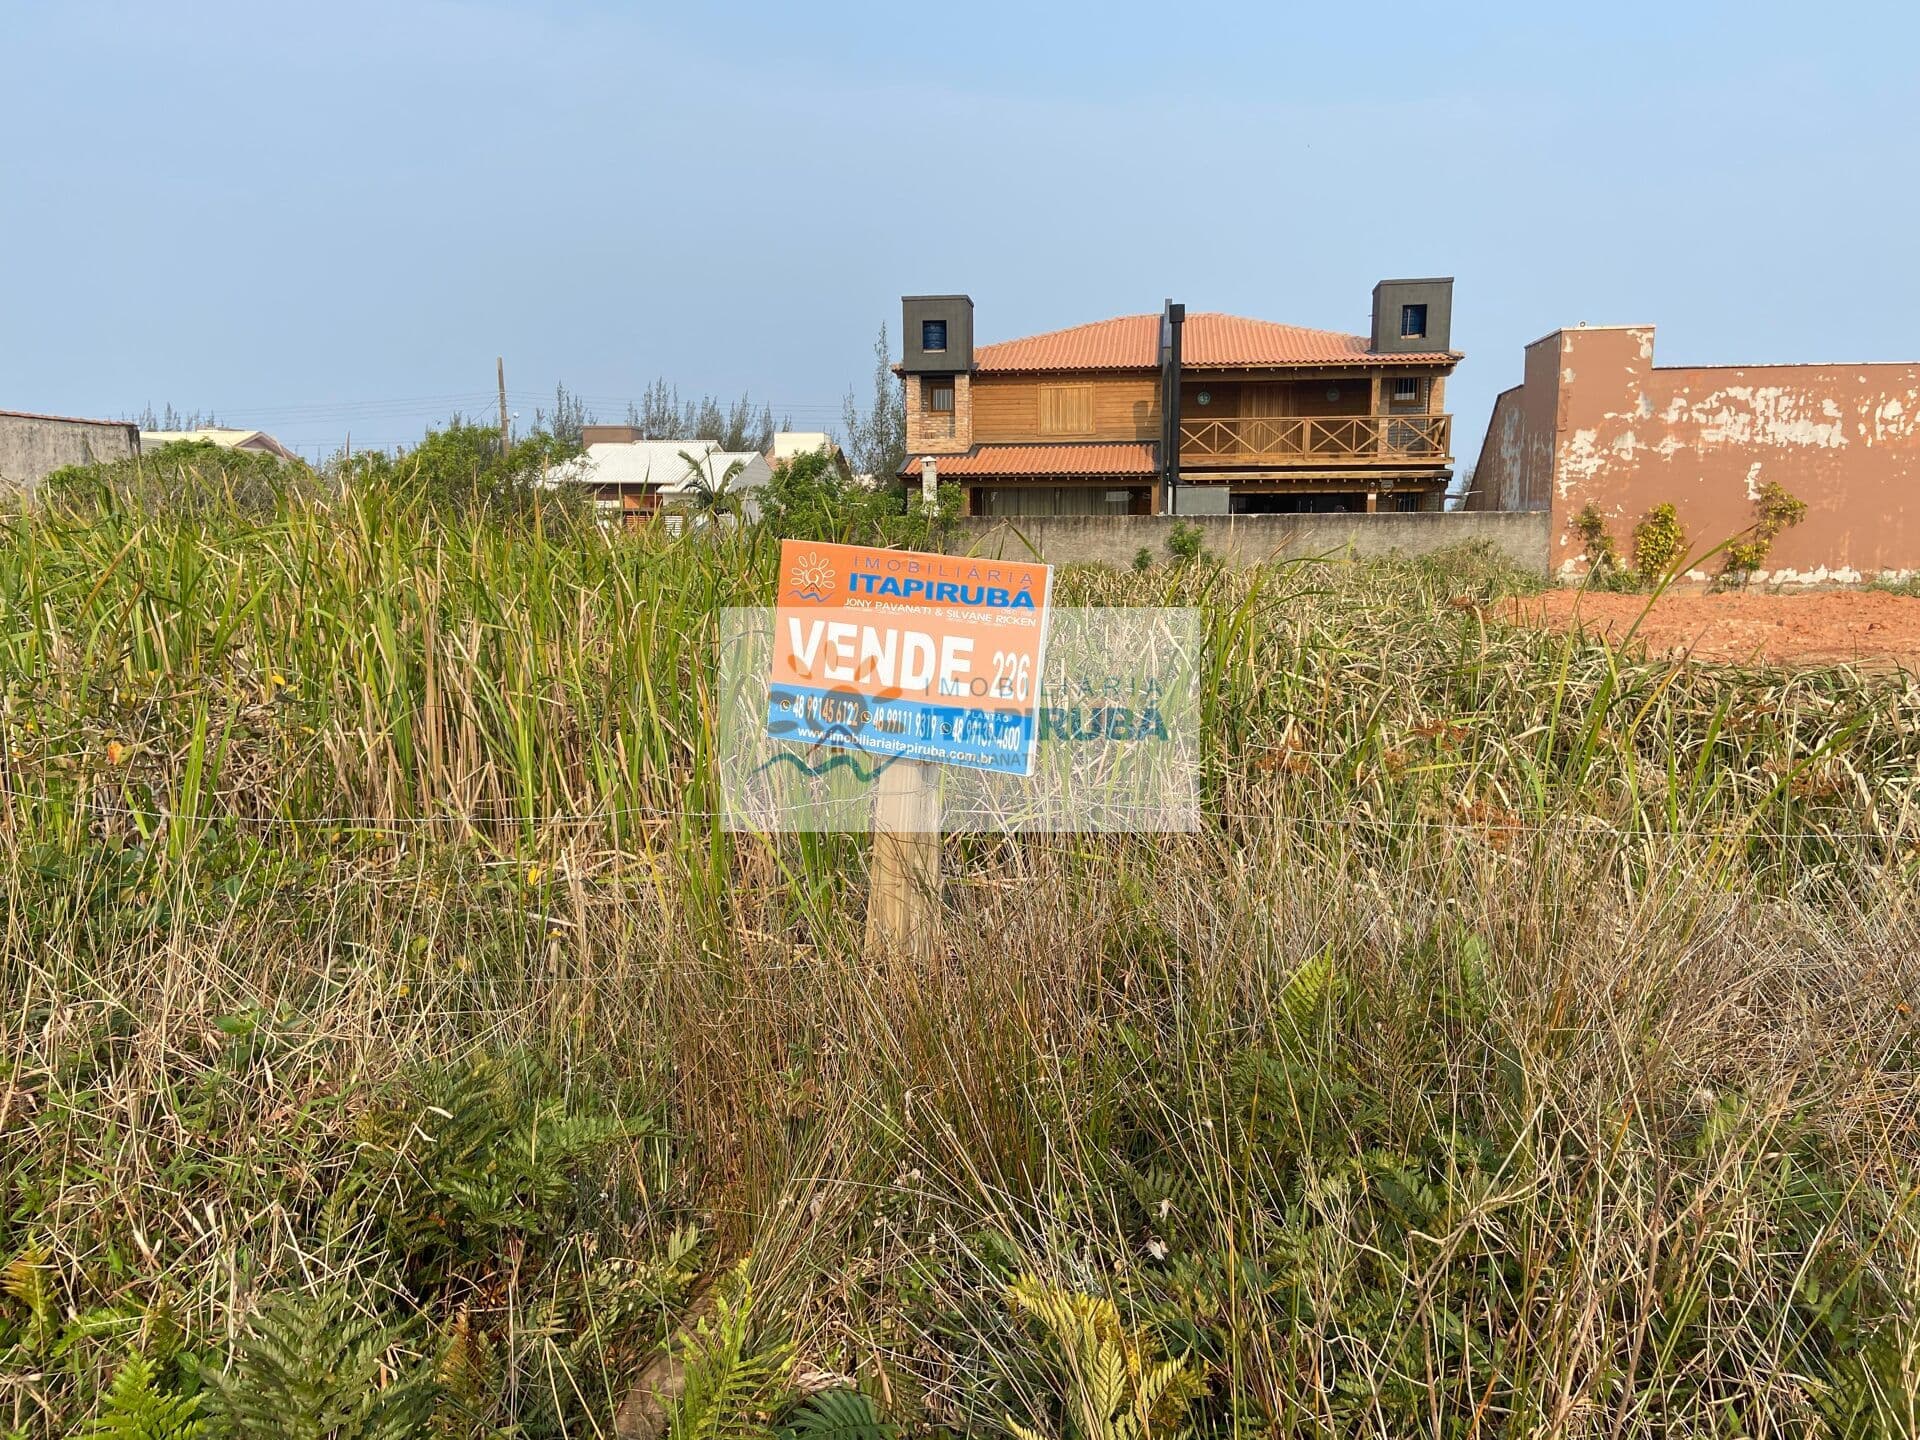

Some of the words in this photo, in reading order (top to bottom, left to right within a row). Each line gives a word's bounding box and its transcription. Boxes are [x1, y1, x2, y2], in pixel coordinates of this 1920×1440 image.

[853, 556, 1033, 585] IMOBILIÁRIA
[849, 572, 1035, 612] ITAPIRUBÁ
[844, 598, 872, 609] JONY
[875, 602, 931, 616] PAVANATI
[935, 608, 943, 616] &
[946, 609, 992, 622] SILVANE
[995, 614, 1036, 627] RICKEN
[788, 617, 974, 697] VENDE
[989, 650, 1031, 701] 226
[793, 694, 804, 719] 48
[835, 701, 859, 726] 6122
[873, 706, 884, 732] 48
[886, 708, 912, 736] 99111
[915, 712, 937, 739] 9319
[952, 717, 964, 743] 48
[798, 727, 993, 764] www.imobiliariaitapiruba.com.br
